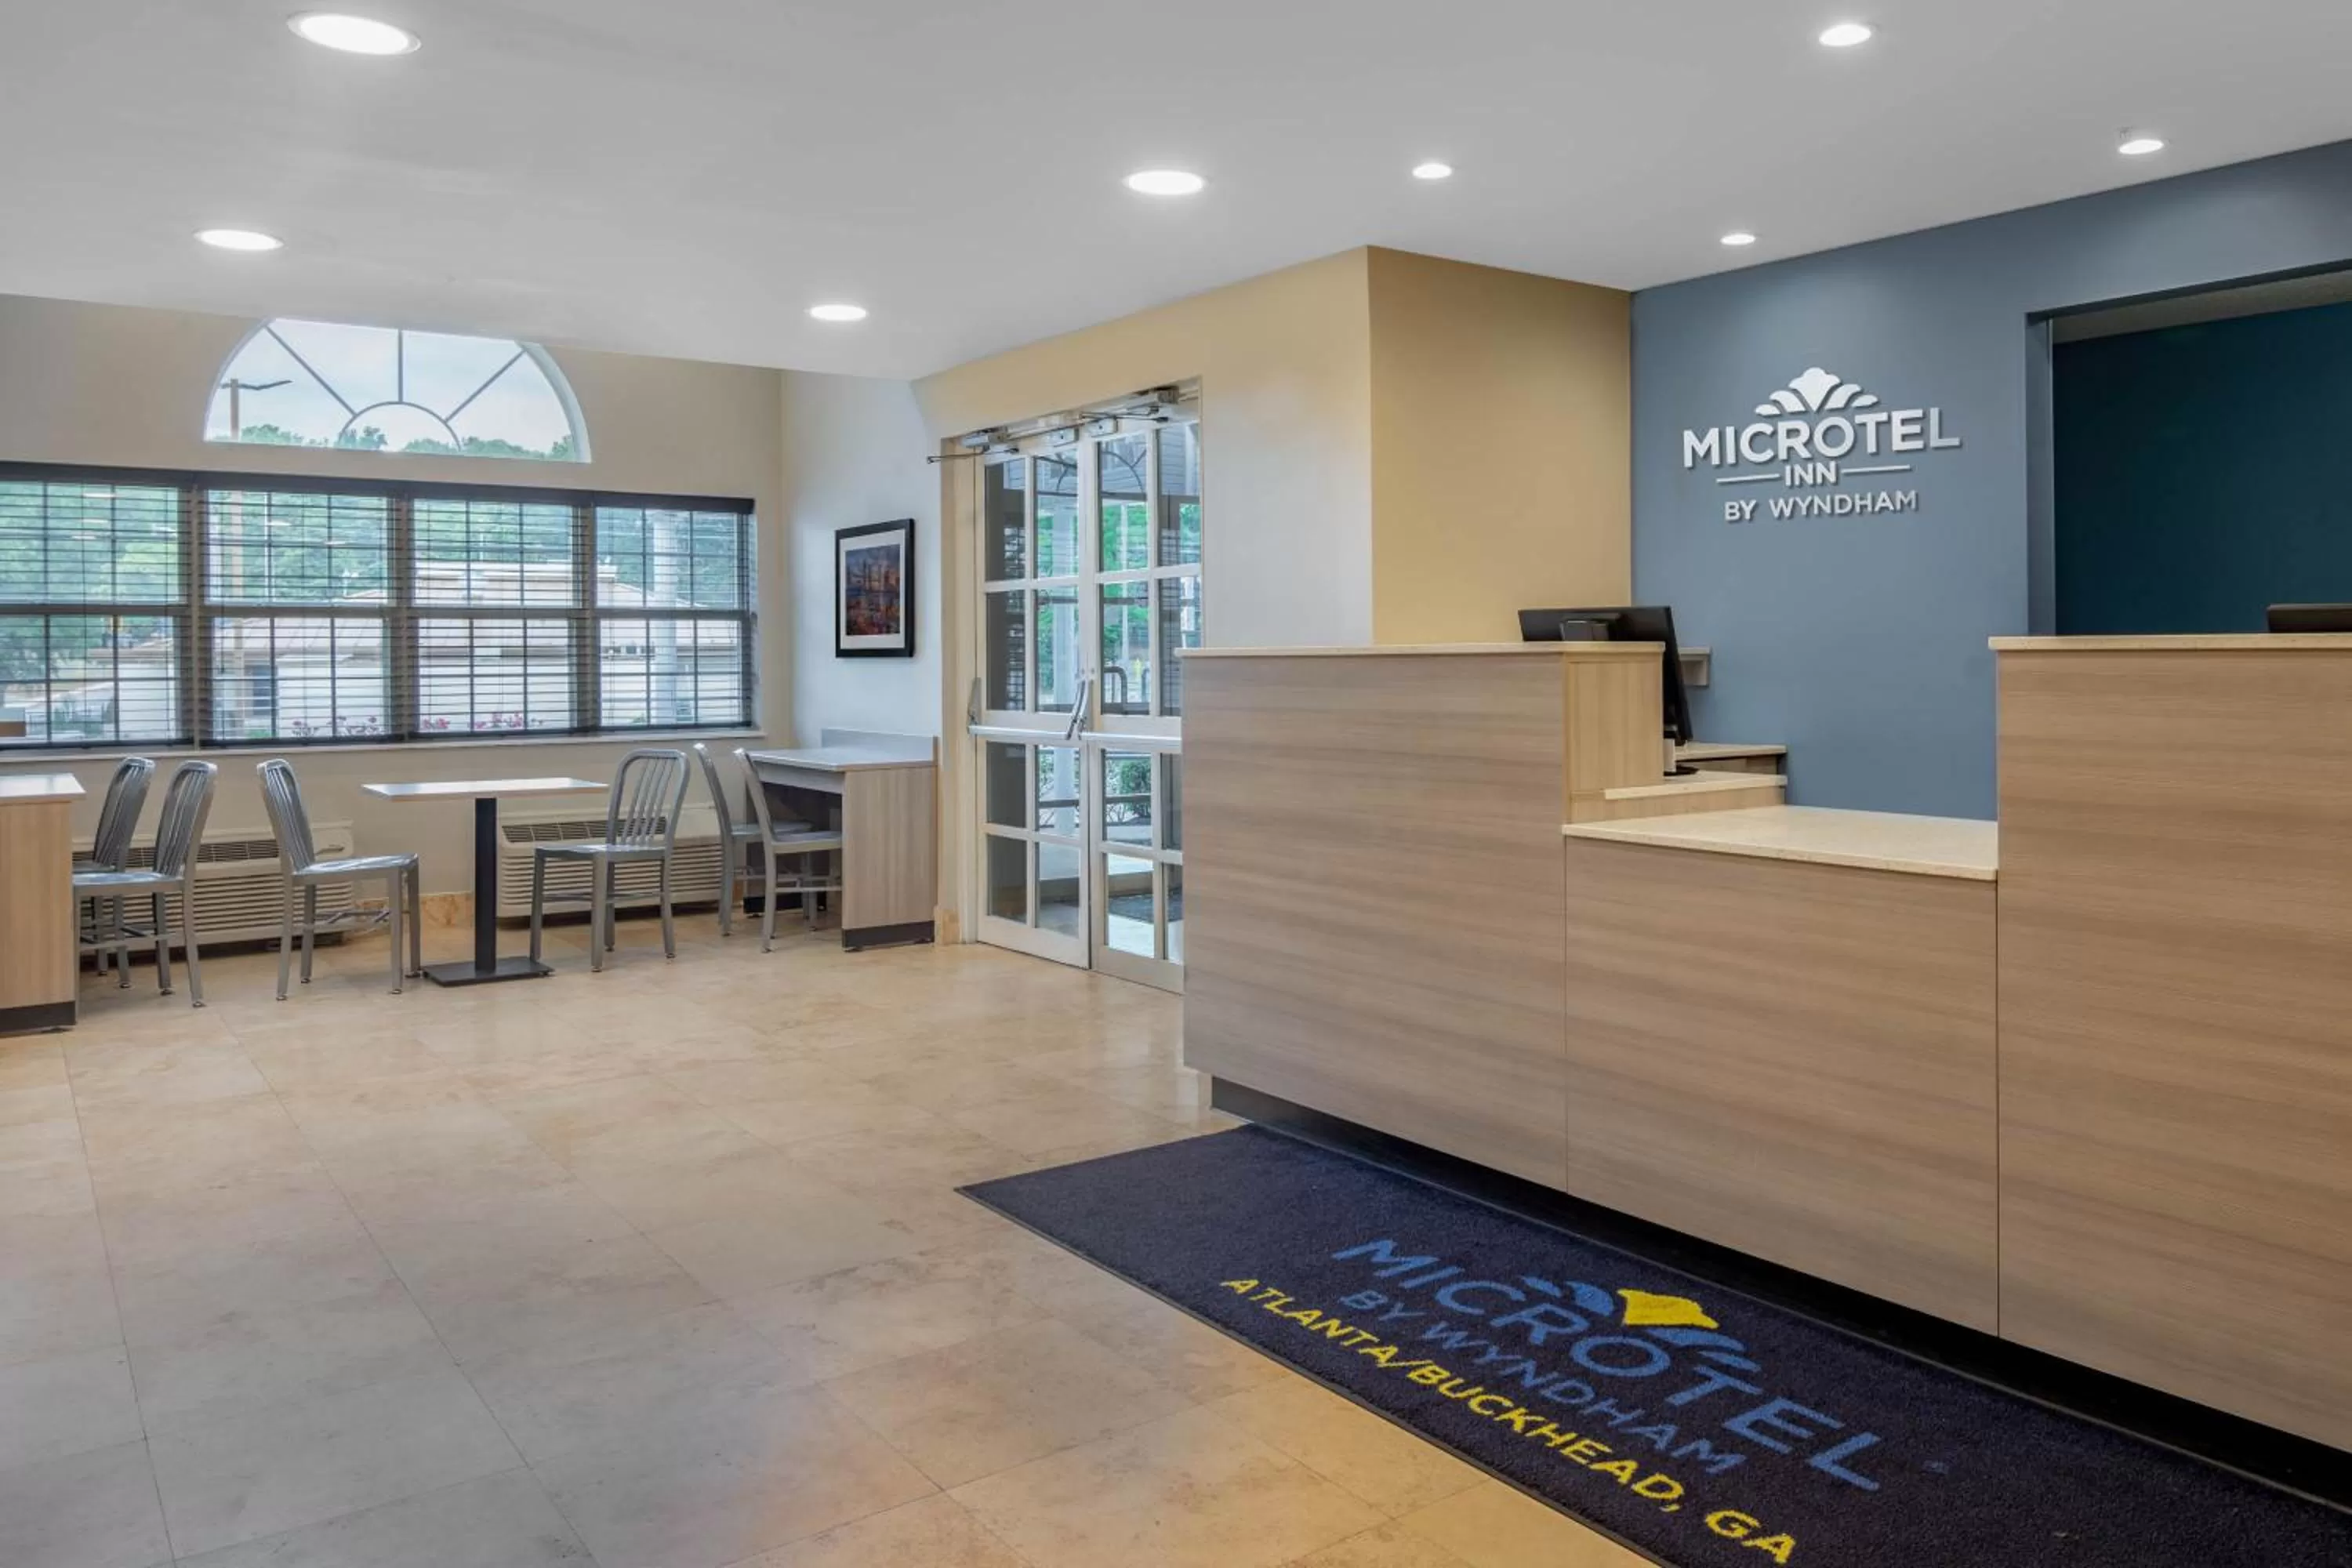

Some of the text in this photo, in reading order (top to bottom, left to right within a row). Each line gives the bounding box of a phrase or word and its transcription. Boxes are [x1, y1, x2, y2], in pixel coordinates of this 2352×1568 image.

[1683, 407, 1961, 469] MICROTEL
[1785, 461, 1838, 487] INN
[1726, 490, 1918, 521] BY WYNDHAM
[1220, 1278, 1798, 1565] ATLANTA/BUCKHEAD, GA
[1332, 1239, 1879, 1492] MICROTEL
[1339, 1290, 1747, 1475] BY WYNDHAM
